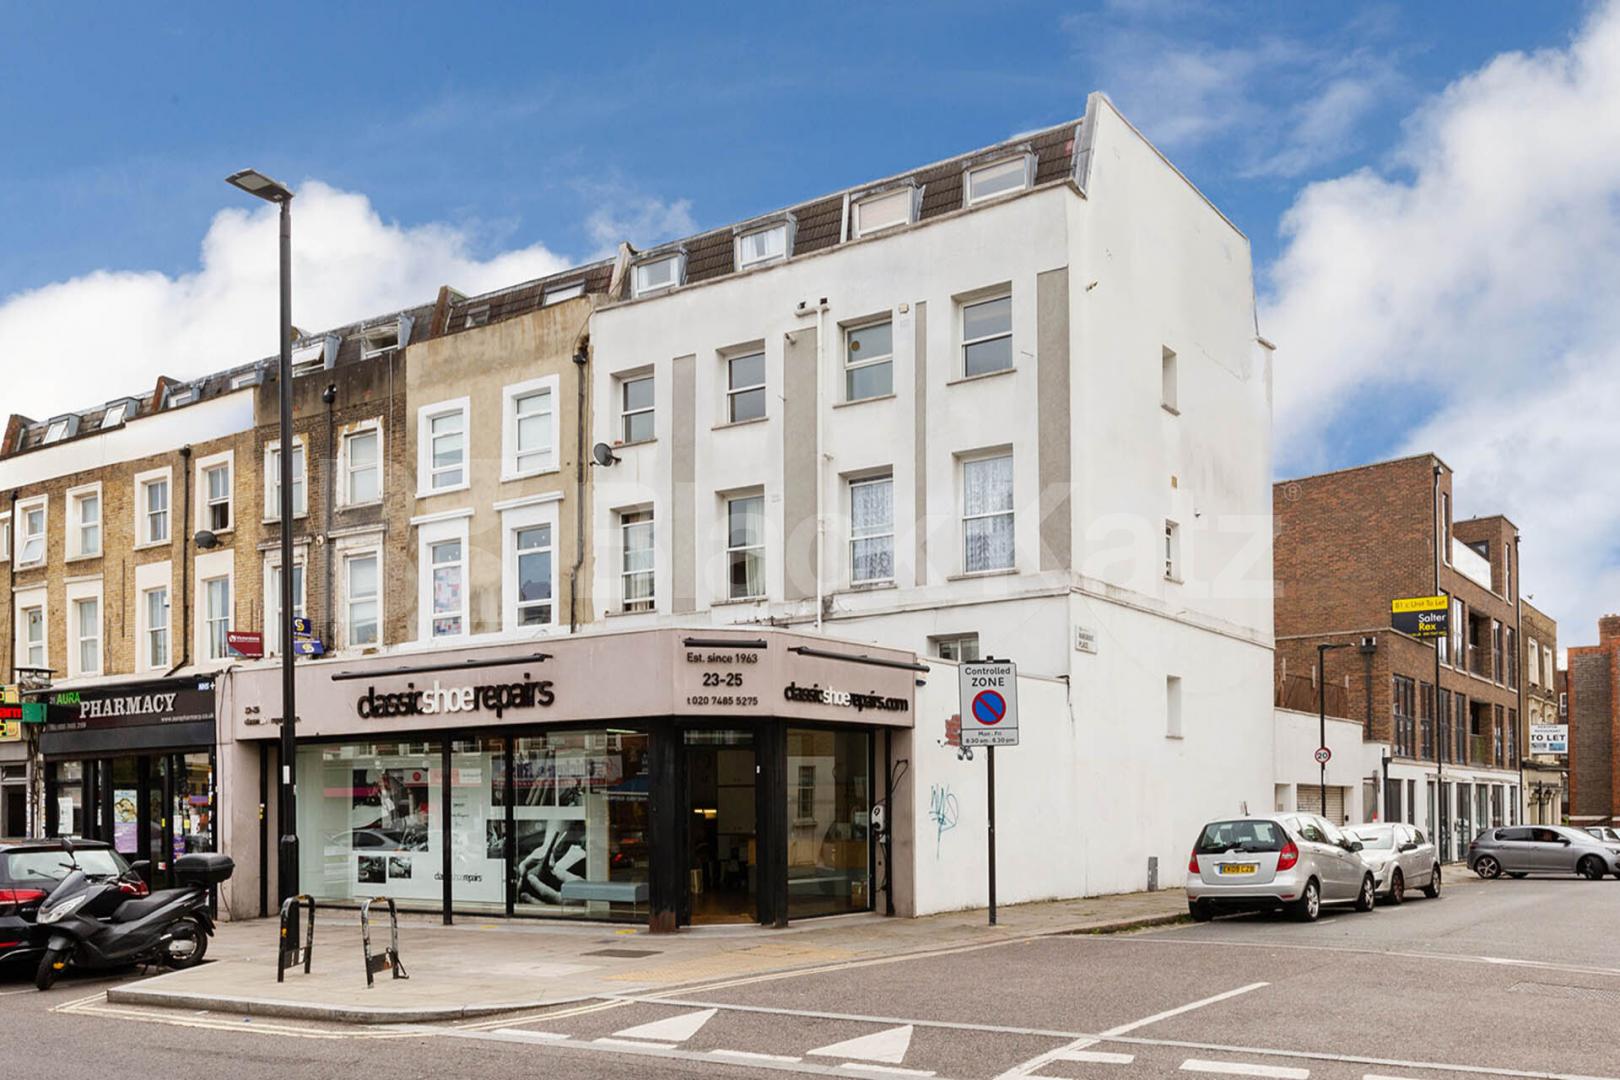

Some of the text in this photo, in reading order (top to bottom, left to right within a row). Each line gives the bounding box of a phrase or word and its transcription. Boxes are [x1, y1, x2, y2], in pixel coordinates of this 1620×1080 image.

[1418, 613, 1446, 623] Salter
[1418, 622, 1437, 631] Rex
[687, 652, 758, 663] Est. since 1963
[965, 666, 1011, 676] Controlled
[703, 672, 743, 687] 23-25
[971, 677, 1005, 687] ZONE
[56, 690, 81, 704] AURA
[357, 672, 555, 719] classicshoerepairs
[79, 693, 177, 719] PHARMACY
[692, 697, 709, 706] 020
[711, 696, 734, 706] 7485
[736, 696, 758, 706] 5275
[1317, 752, 1328, 760] 20
